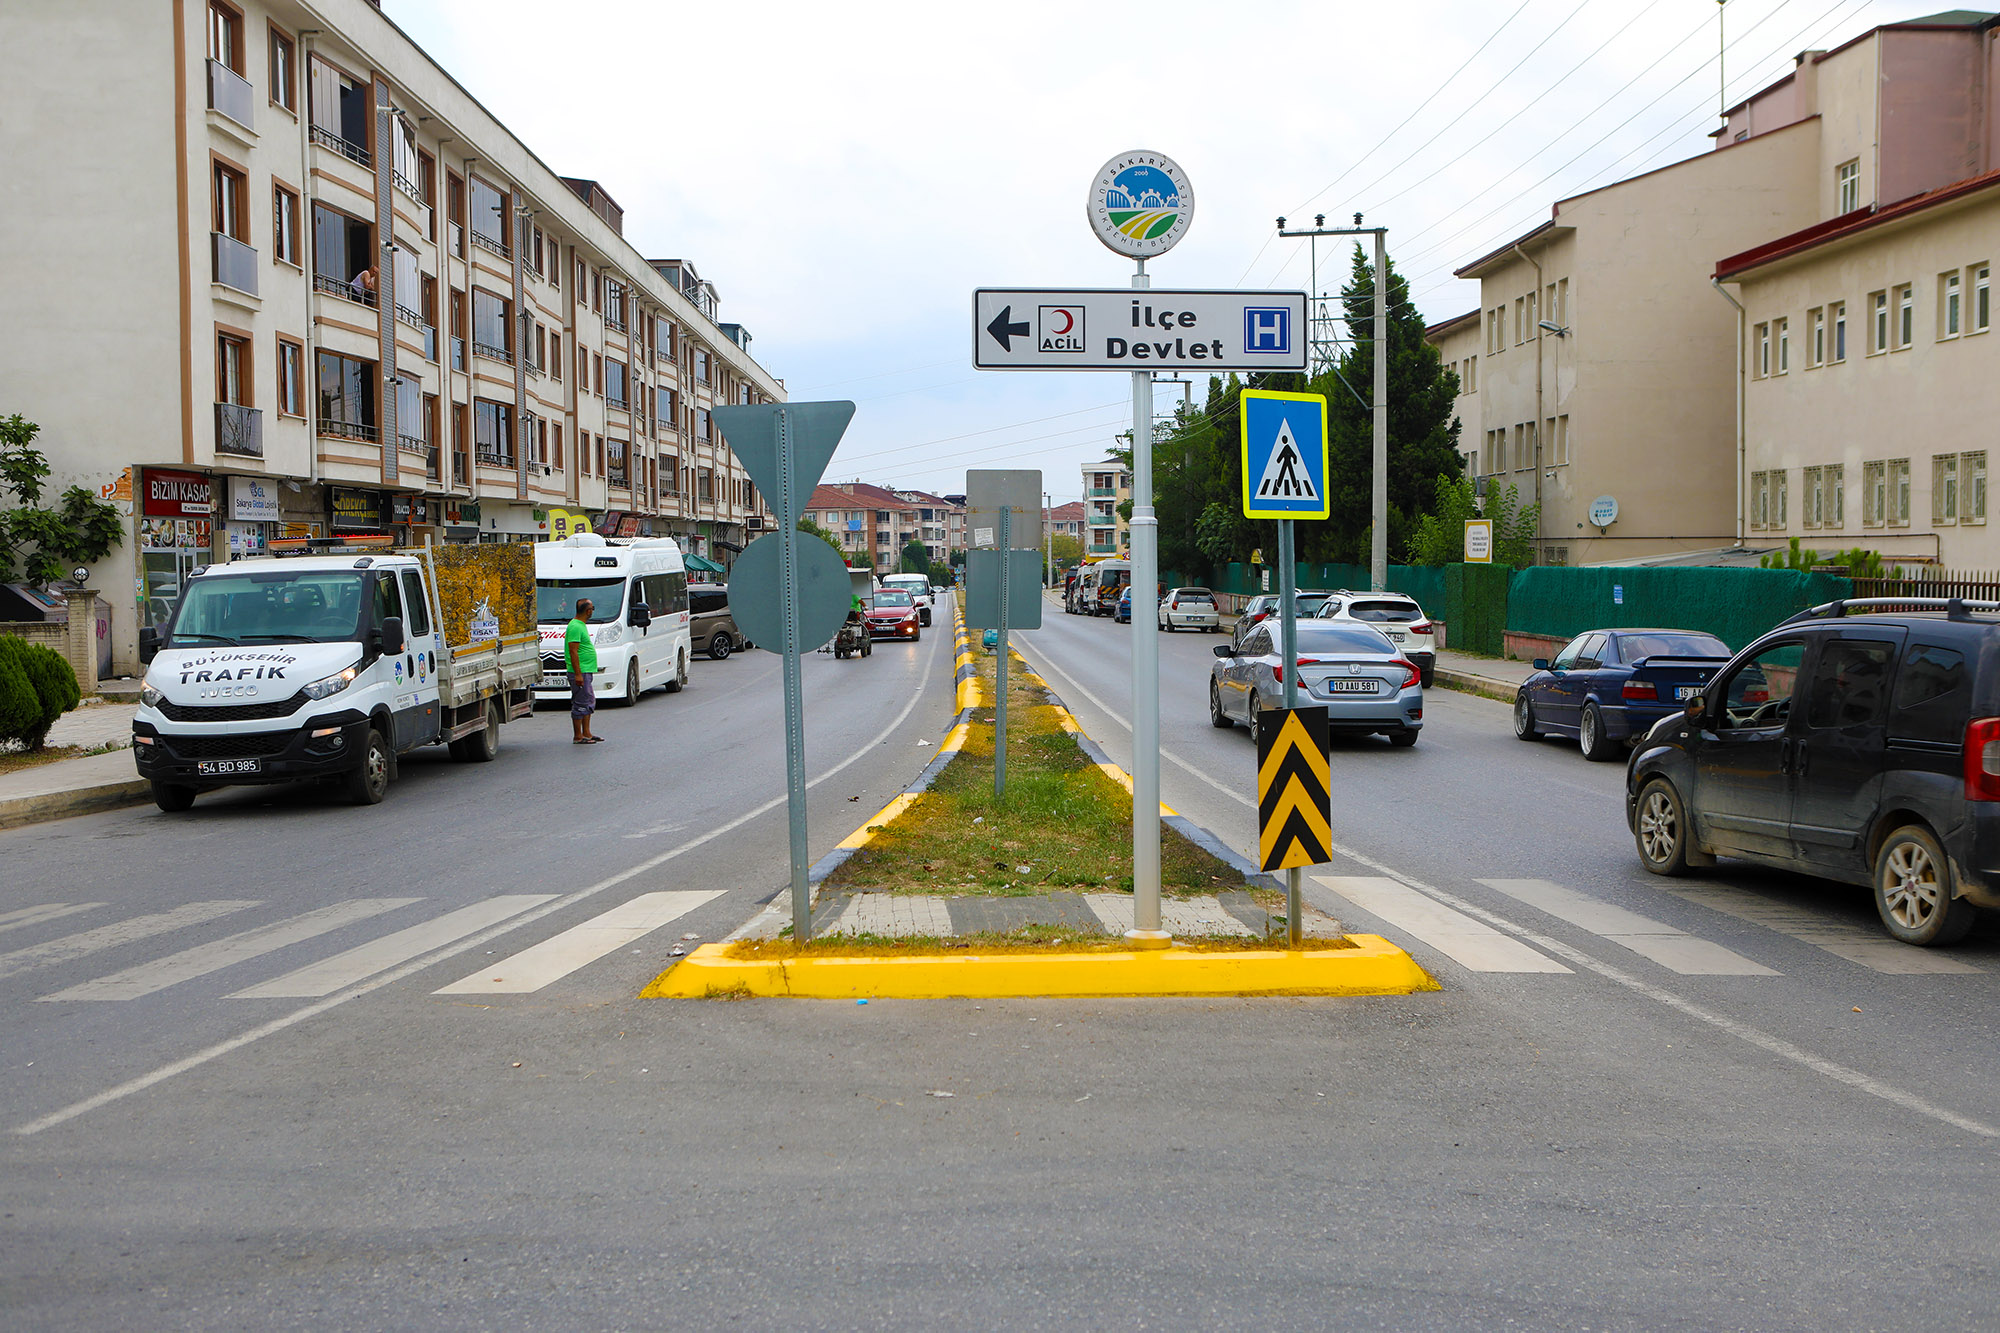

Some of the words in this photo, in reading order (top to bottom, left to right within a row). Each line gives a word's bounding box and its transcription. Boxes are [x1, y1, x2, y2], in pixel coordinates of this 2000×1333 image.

[1110, 157, 1174, 176] SAKARYA
[1131, 300, 1197, 331] İlçe
[1042, 335, 1083, 350] ACİL
[1106, 337, 1224, 360] Devlet
[151, 480, 179, 501] BİZİM
[180, 482, 211, 502] KASAP
[180, 665, 287, 685] TRAFİK
[200, 684, 259, 699] IVECO
[1334, 681, 1343, 691] 10
[1346, 681, 1360, 691] AAU
[1361, 681, 1375, 691] 581
[1680, 688, 1689, 697] 16
[202, 762, 216, 774] 54
[218, 761, 235, 773] BD
[236, 760, 257, 772] 985
